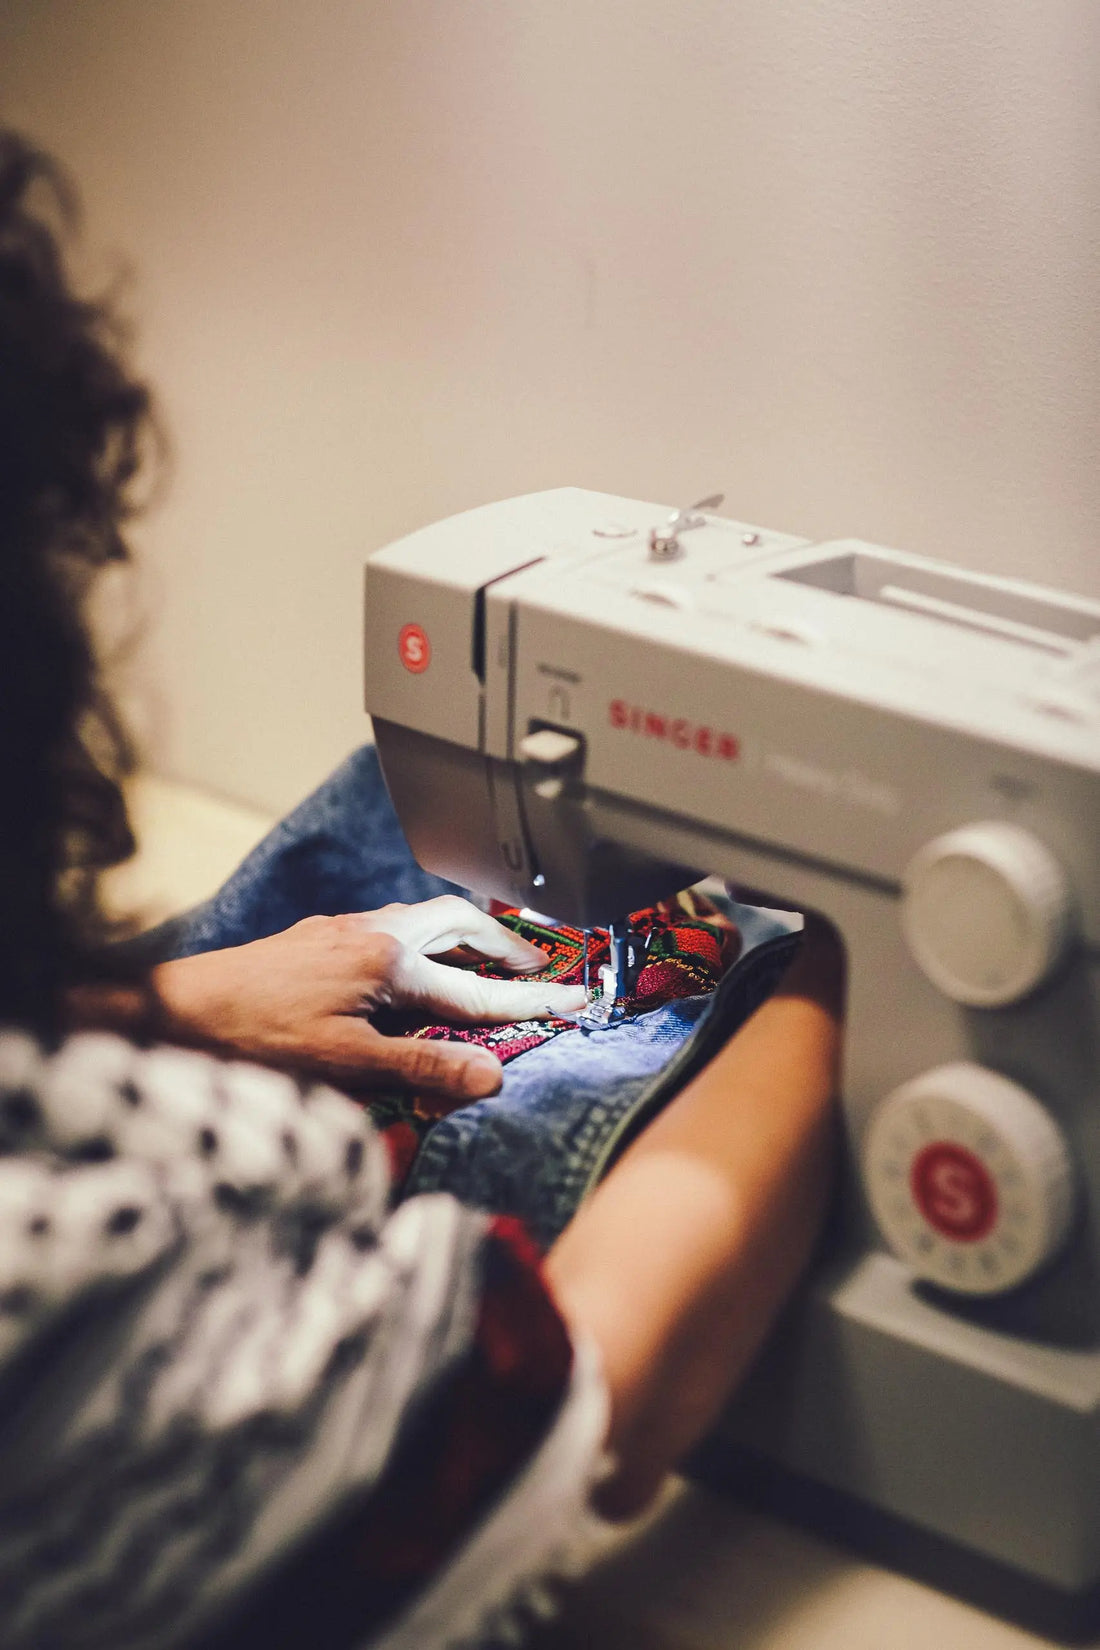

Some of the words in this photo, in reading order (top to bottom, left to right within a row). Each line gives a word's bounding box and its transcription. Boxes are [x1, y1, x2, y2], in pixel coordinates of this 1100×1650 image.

[405, 635, 423, 662] S
[608, 698, 742, 763] SINGER
[932, 1163, 975, 1221] S
